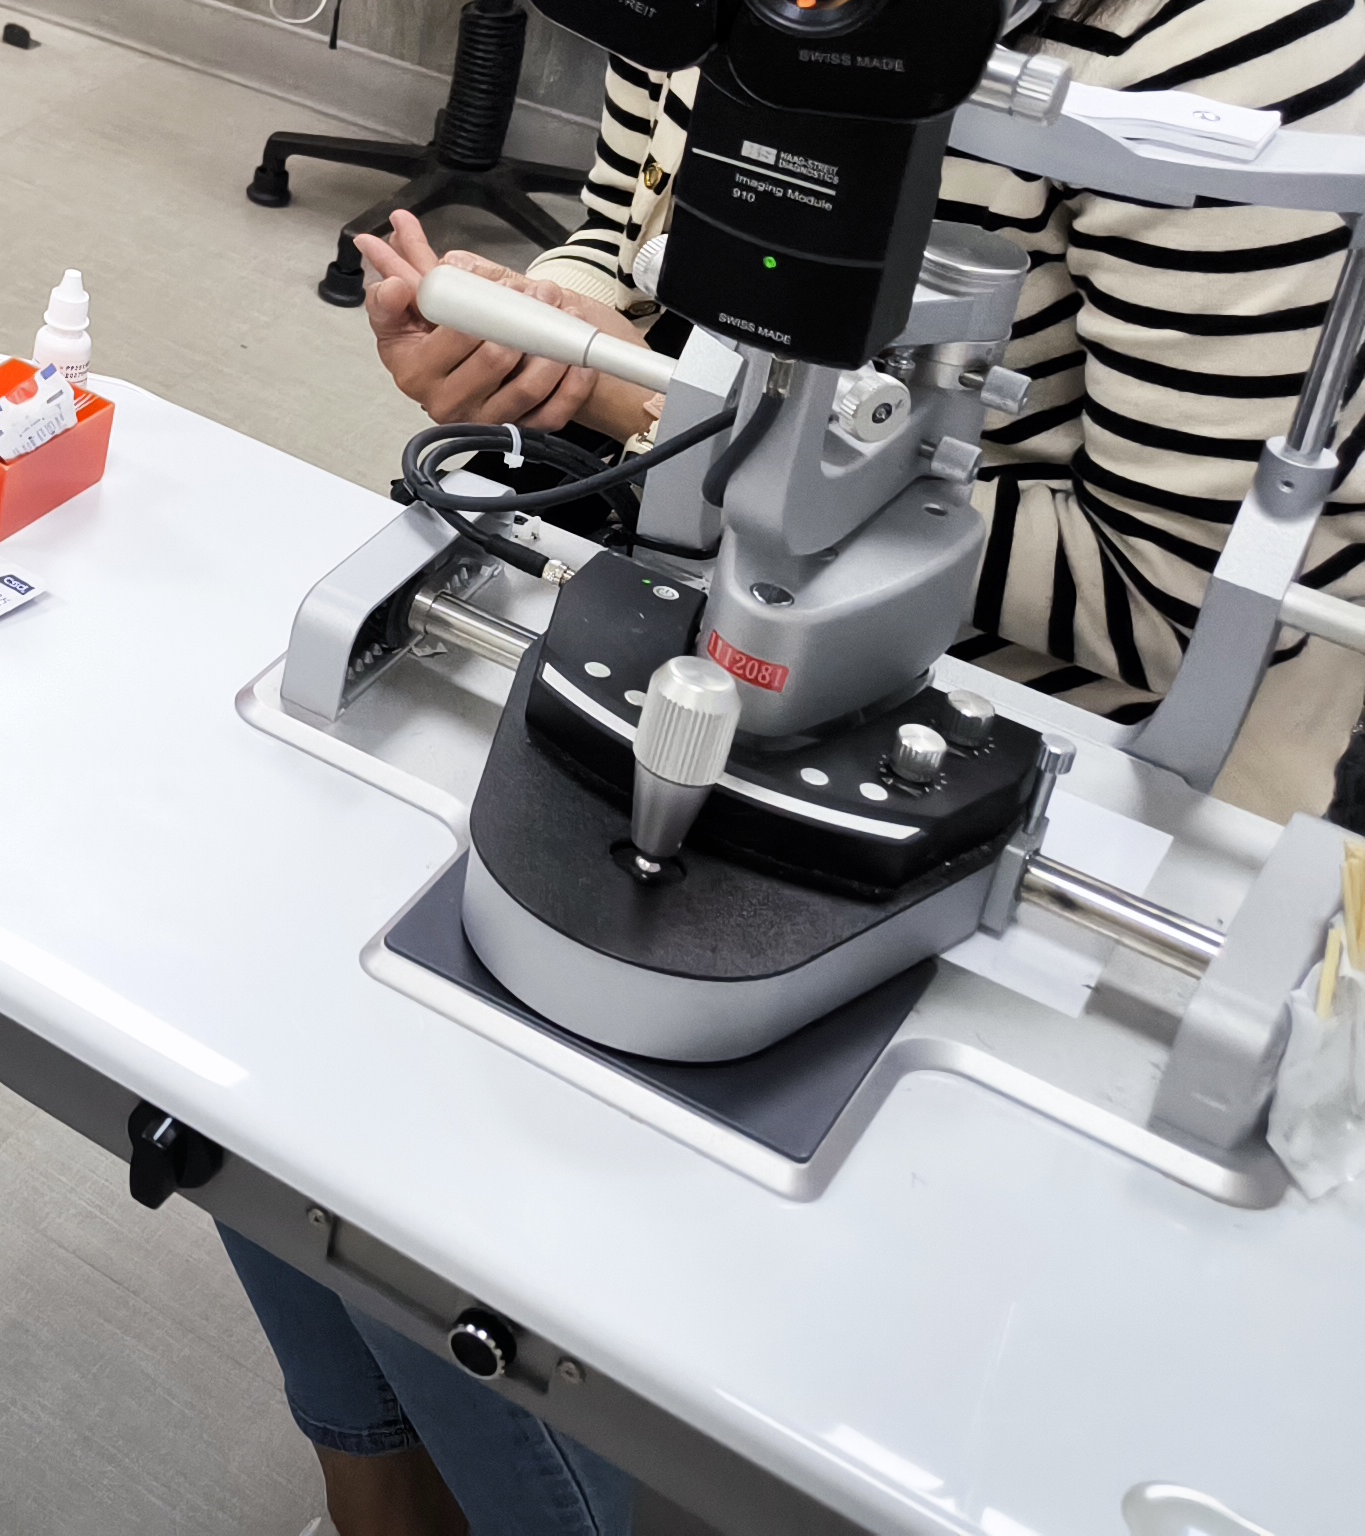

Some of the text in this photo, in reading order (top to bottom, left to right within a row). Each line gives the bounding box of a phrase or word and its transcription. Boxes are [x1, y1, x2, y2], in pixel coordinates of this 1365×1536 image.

[732, 187, 756, 203] 910
[735, 172, 833, 212] Imaging Module
[718, 312, 792, 345] SWISS MADE
